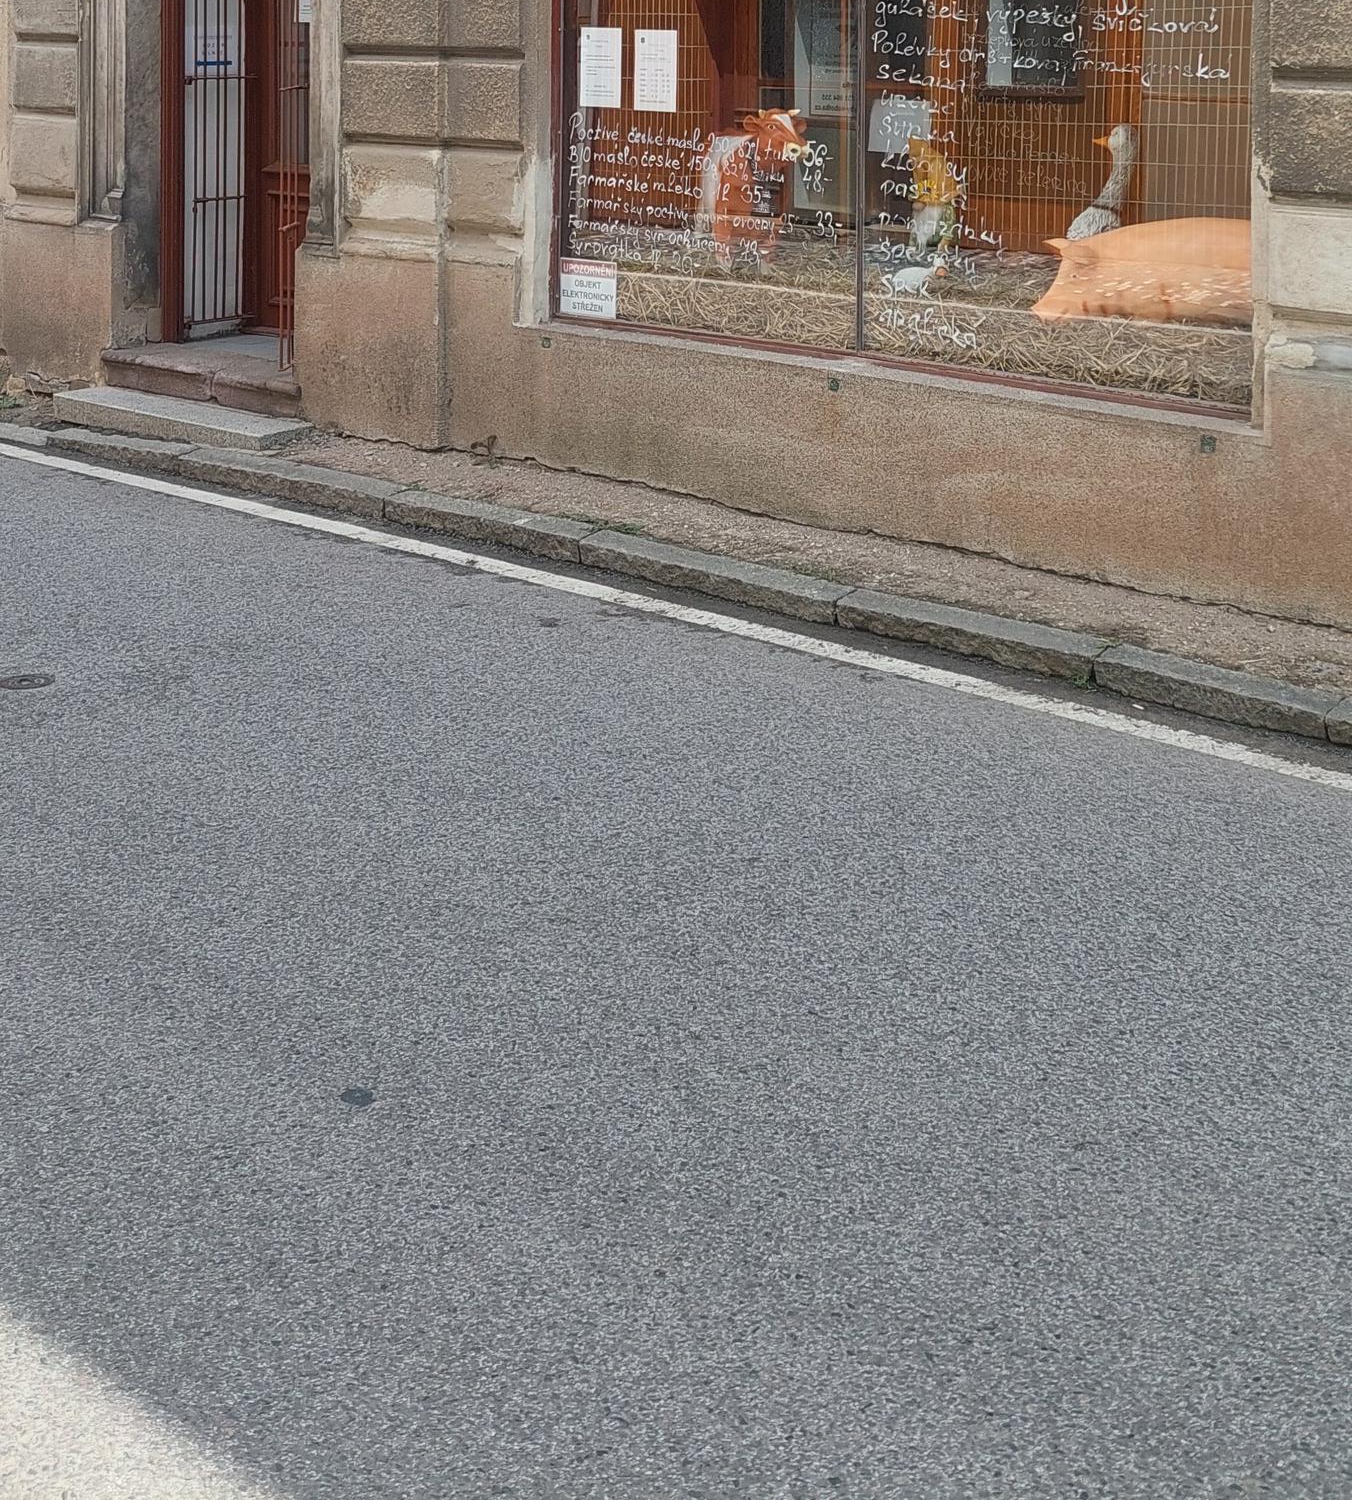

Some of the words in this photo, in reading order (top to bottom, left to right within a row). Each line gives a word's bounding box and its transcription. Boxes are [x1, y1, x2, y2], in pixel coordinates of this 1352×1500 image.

[568, 111, 619, 144] Poctivé
[563, 262, 614, 277] UPOZORNĚNÍ
[574, 279, 602, 290] OBJEKT
[562, 289, 614, 303] ELEKTRONICKY
[571, 301, 604, 313] STŘEŽEN
